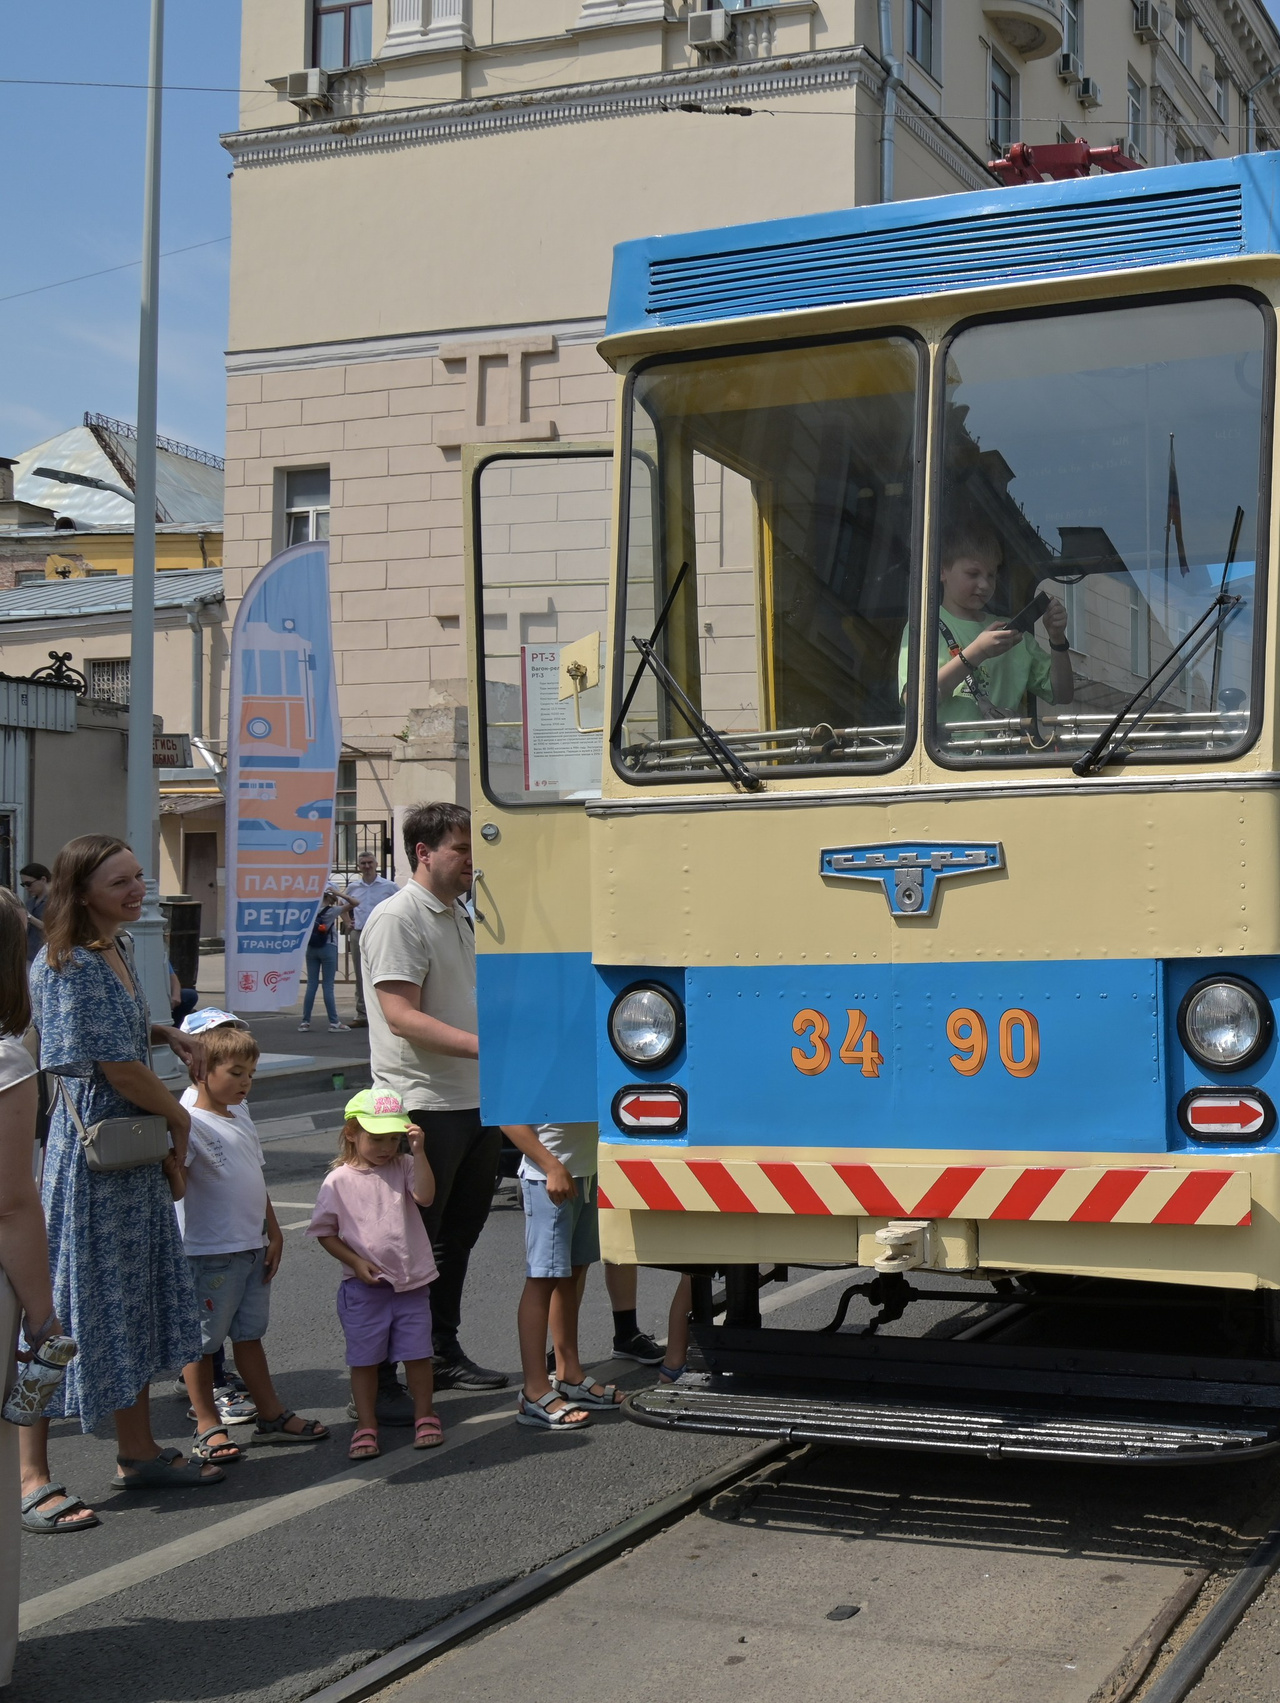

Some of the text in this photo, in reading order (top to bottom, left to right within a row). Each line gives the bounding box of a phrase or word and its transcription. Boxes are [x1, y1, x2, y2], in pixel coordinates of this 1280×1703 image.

[531, 652, 556, 662] РТ-3
[244, 875, 320, 893] ПАРАД
[243, 908, 311, 926] РЕТРО
[791, 1007, 1041, 1078] 34 90
